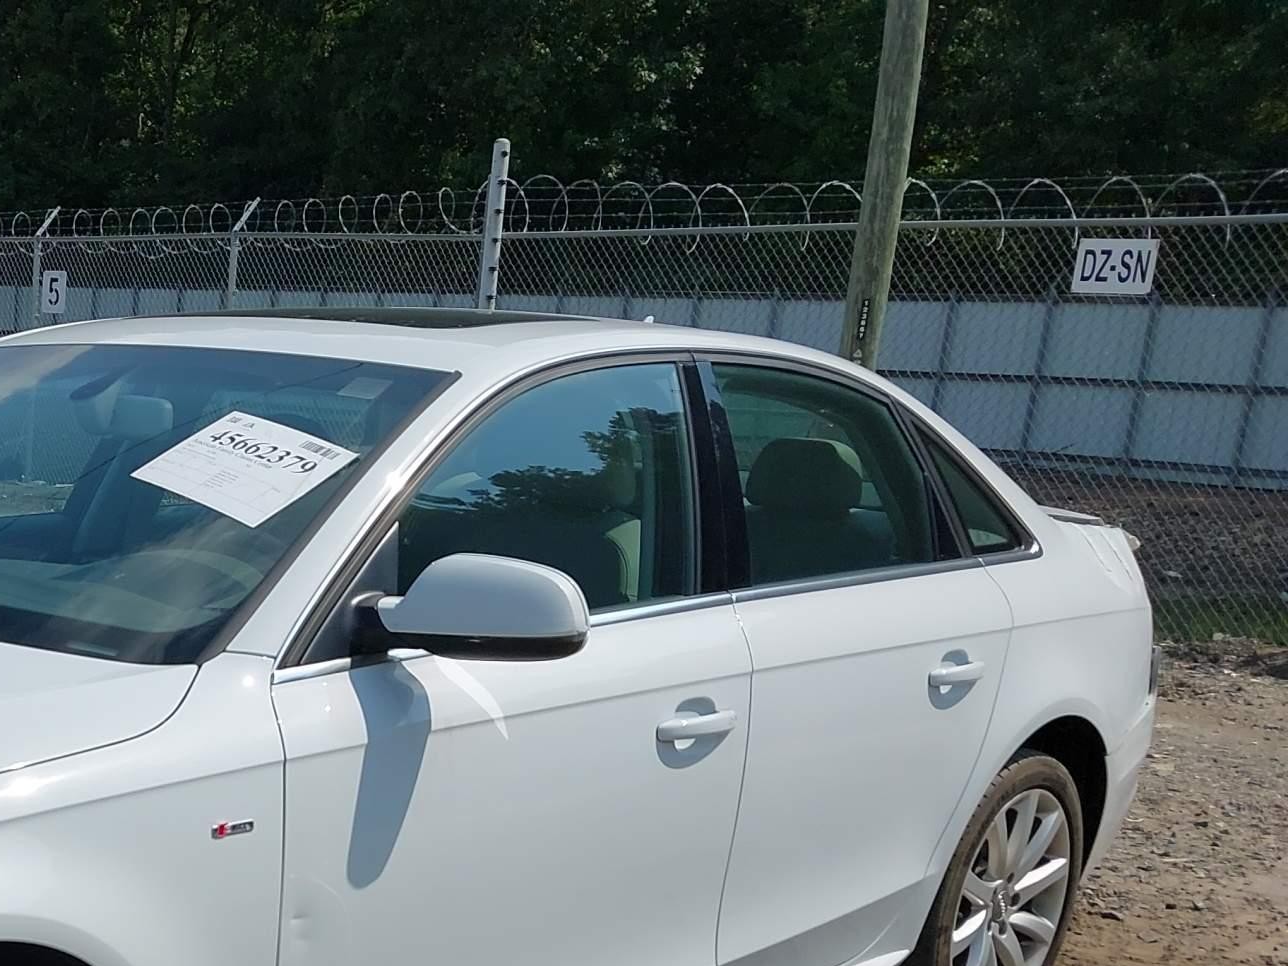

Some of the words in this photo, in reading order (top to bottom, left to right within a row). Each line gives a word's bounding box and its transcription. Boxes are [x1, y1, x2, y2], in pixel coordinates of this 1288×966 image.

[1079, 249, 1152, 283] DZ-SN
[48, 277, 60, 305] 5
[210, 430, 318, 474] 45662379
